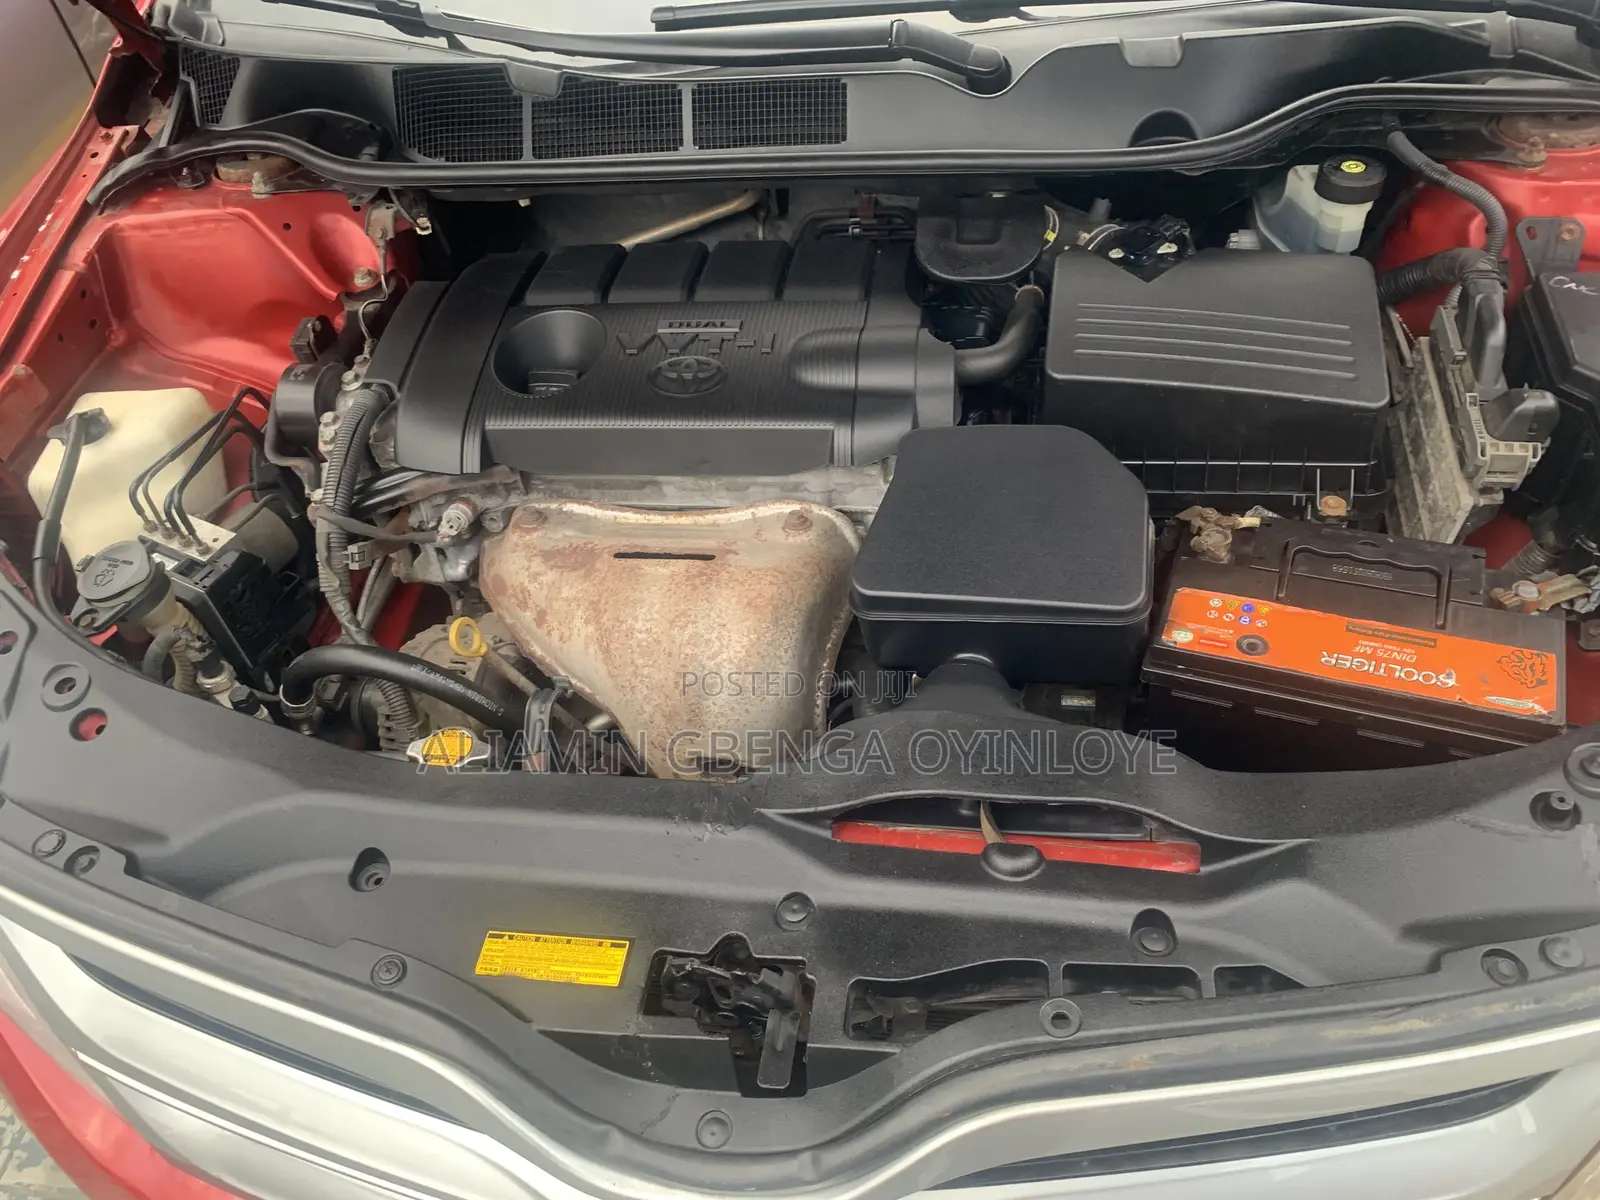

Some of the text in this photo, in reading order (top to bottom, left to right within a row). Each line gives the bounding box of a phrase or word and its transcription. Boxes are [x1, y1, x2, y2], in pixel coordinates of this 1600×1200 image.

[1352, 645, 1418, 663] DIN75 MF
[513, 934, 537, 942] CAUTION
